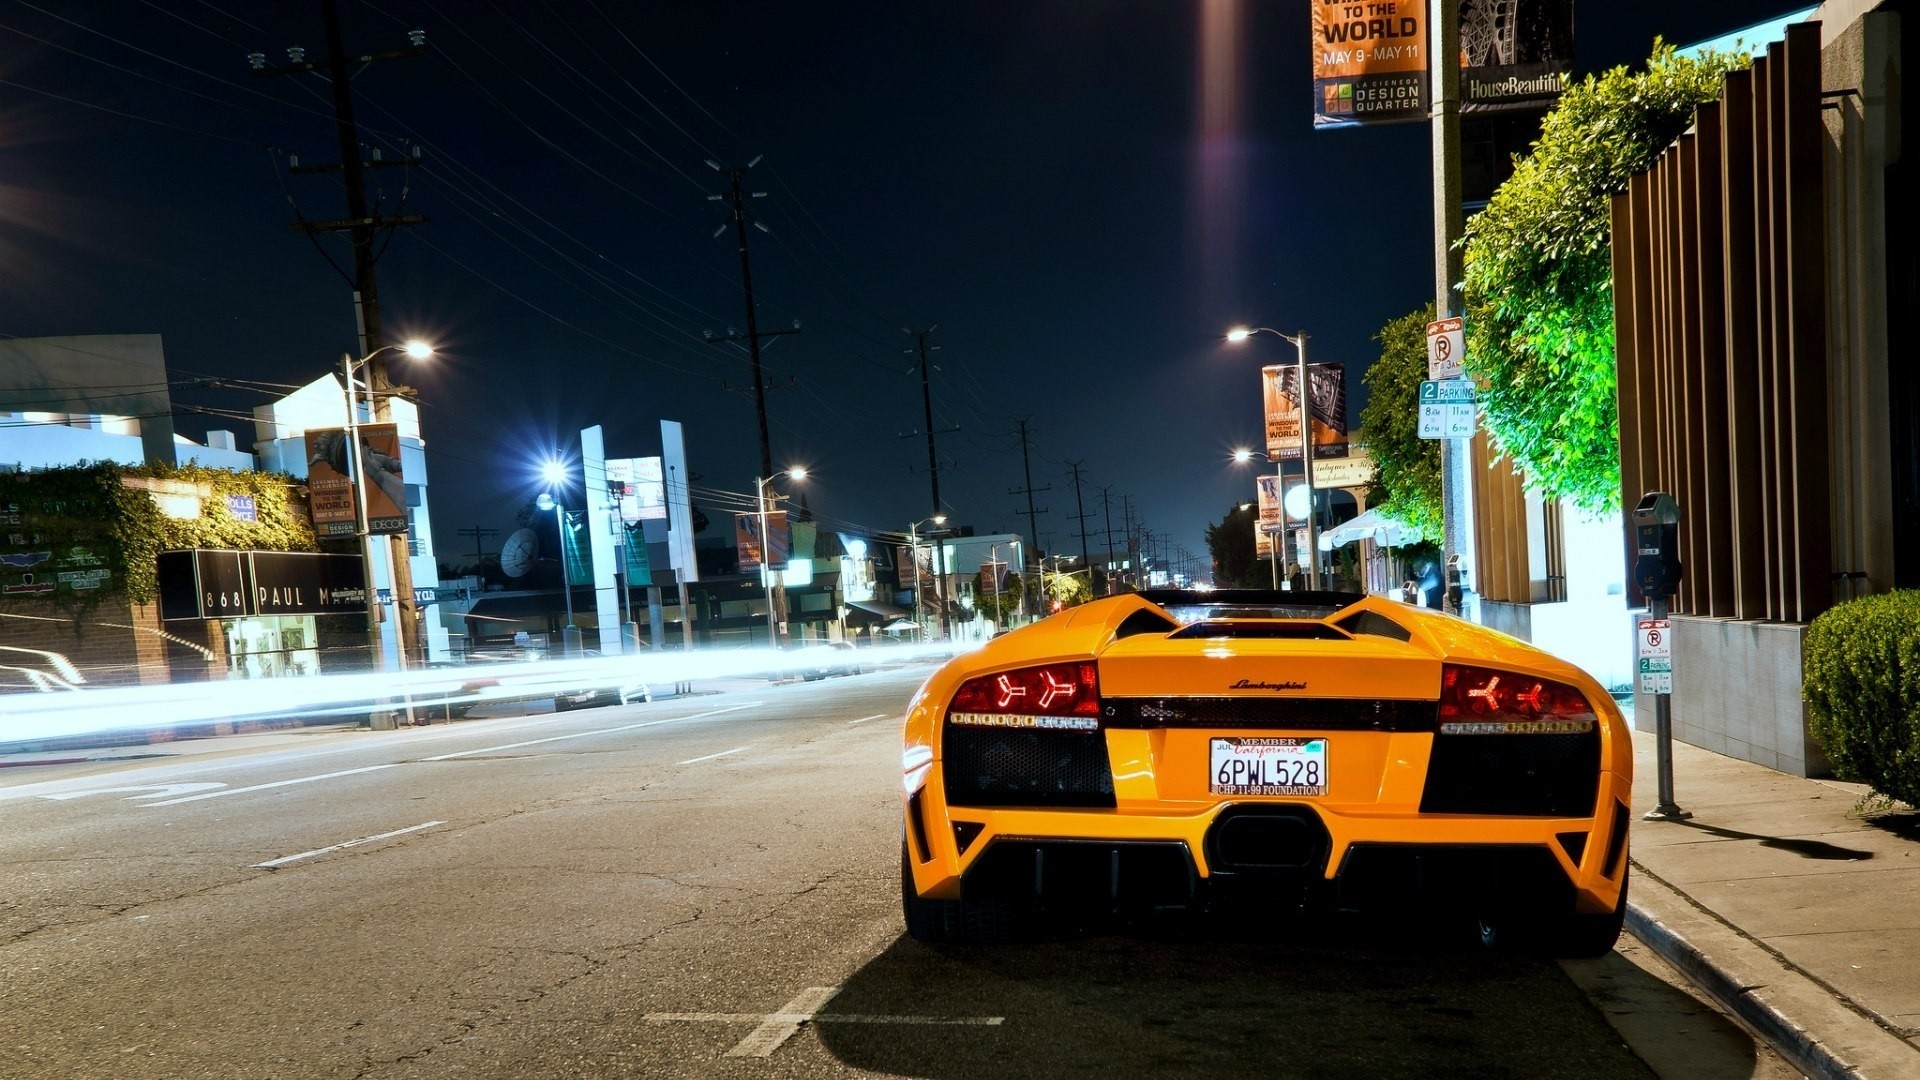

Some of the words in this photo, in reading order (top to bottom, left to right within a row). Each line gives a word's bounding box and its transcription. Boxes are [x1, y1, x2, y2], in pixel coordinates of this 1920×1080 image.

[1344, 6, 1363, 19] TO
[1367, 3, 1396, 17] THE
[1323, 17, 1417, 44] WORLD
[1323, 50, 1352, 66] MAY
[1405, 45, 1419, 58] 11
[1372, 79, 1419, 88] CIENEGA
[1470, 72, 1562, 99] HouseBeautifu
[1356, 86, 1419, 101] DESIGN
[1356, 99, 1419, 112] QUARTER
[1424, 383, 1434, 398] 2
[1439, 387, 1475, 400] PARKING
[1268, 419, 1299, 427] WINDOWS
[1269, 430, 1300, 439] WORLD
[315, 500, 350, 510] WORLD
[374, 519, 406, 530] DECOR
[259, 586, 303, 606] PAUL
[1641, 659, 1648, 669] 2
[1229, 679, 1307, 691] Lamborghini
[1240, 738, 1297, 746] MEMBER
[1234, 744, 1304, 759] California
[1218, 759, 1319, 786] 6PWL528
[1218, 785, 1236, 795] CHP
[1239, 785, 1261, 795] 11-99
[1263, 785, 1320, 795] FOUNDATION
